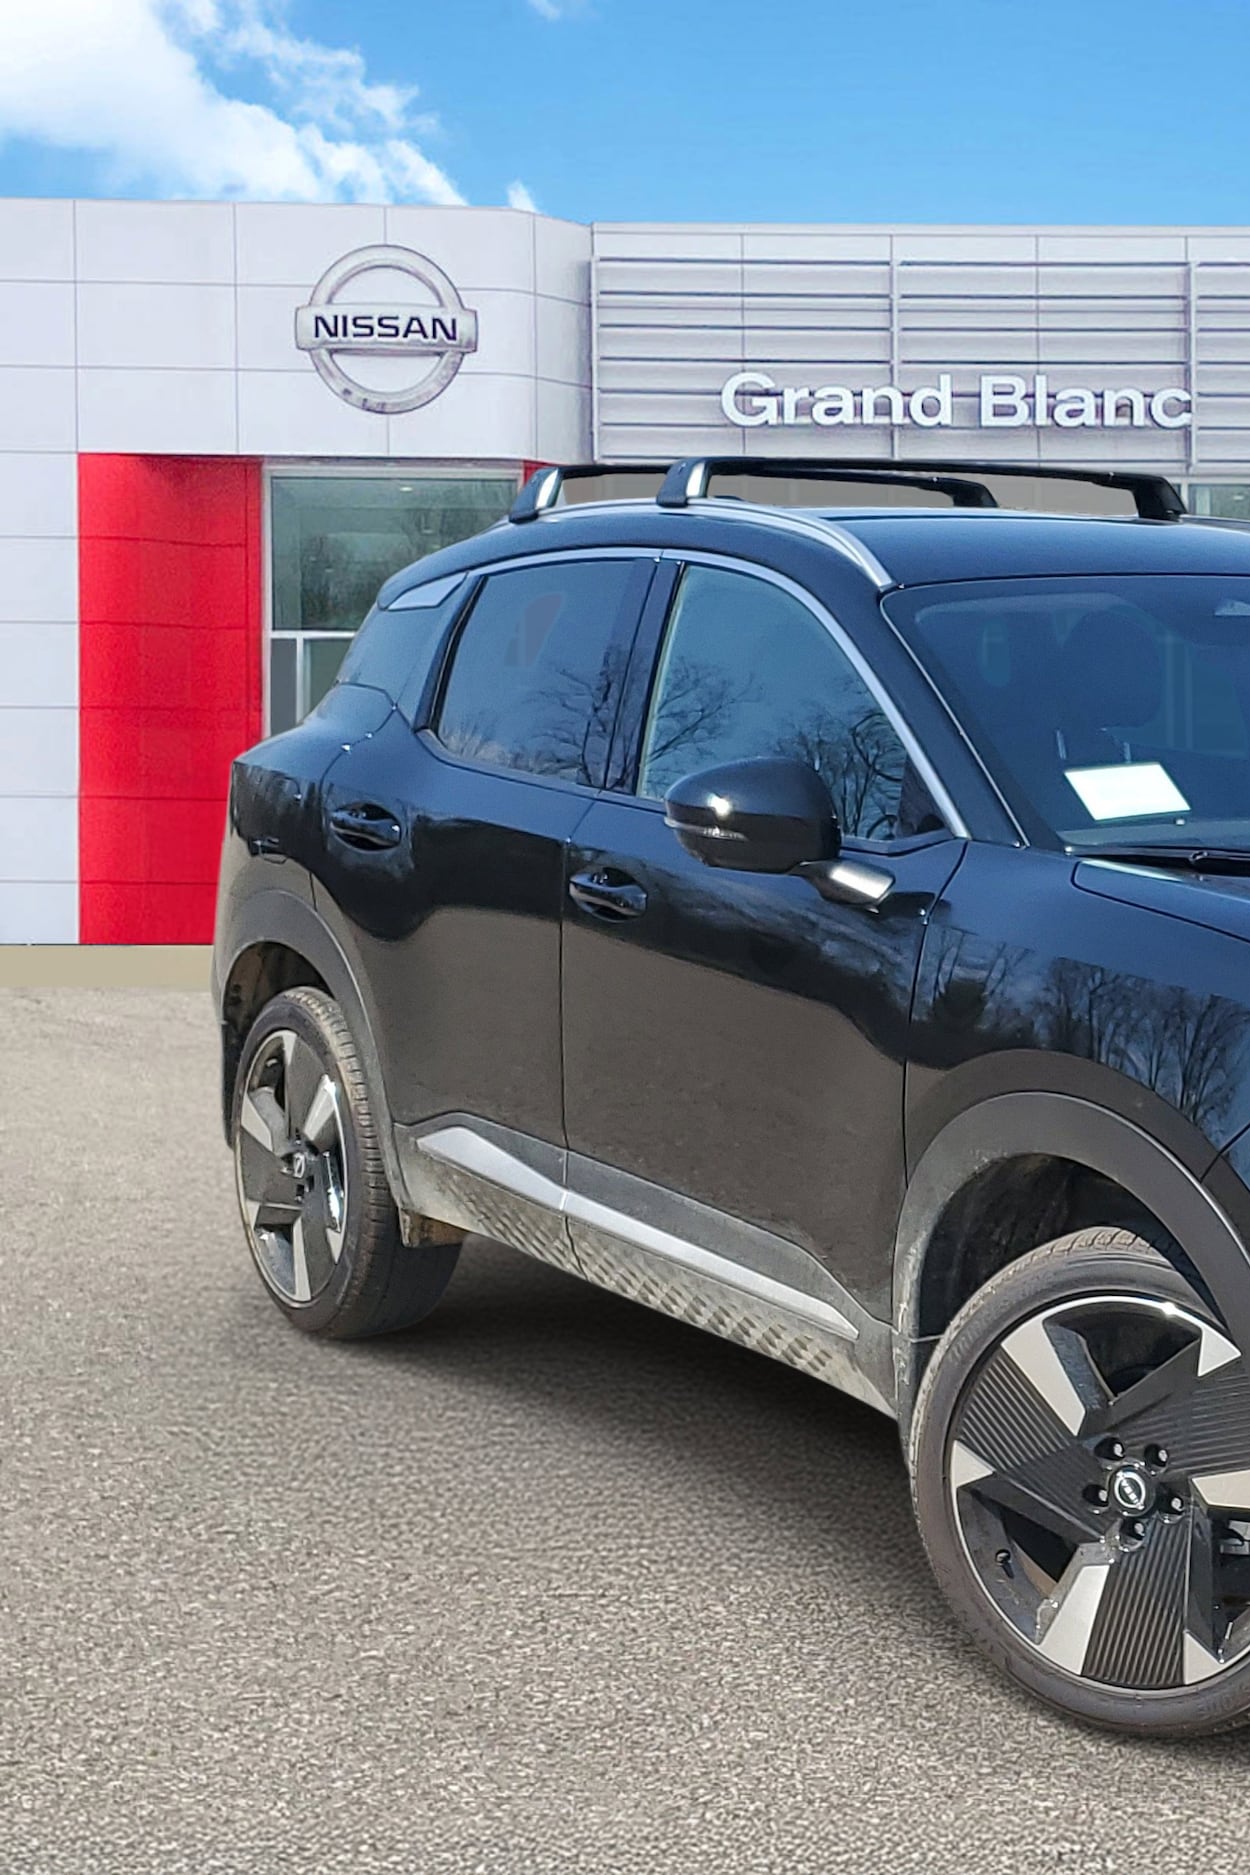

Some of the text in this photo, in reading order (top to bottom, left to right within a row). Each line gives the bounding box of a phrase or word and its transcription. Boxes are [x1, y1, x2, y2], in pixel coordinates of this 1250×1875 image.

[314, 314, 458, 341] NISSAN
[720, 372, 1193, 428] Grand Blanc
